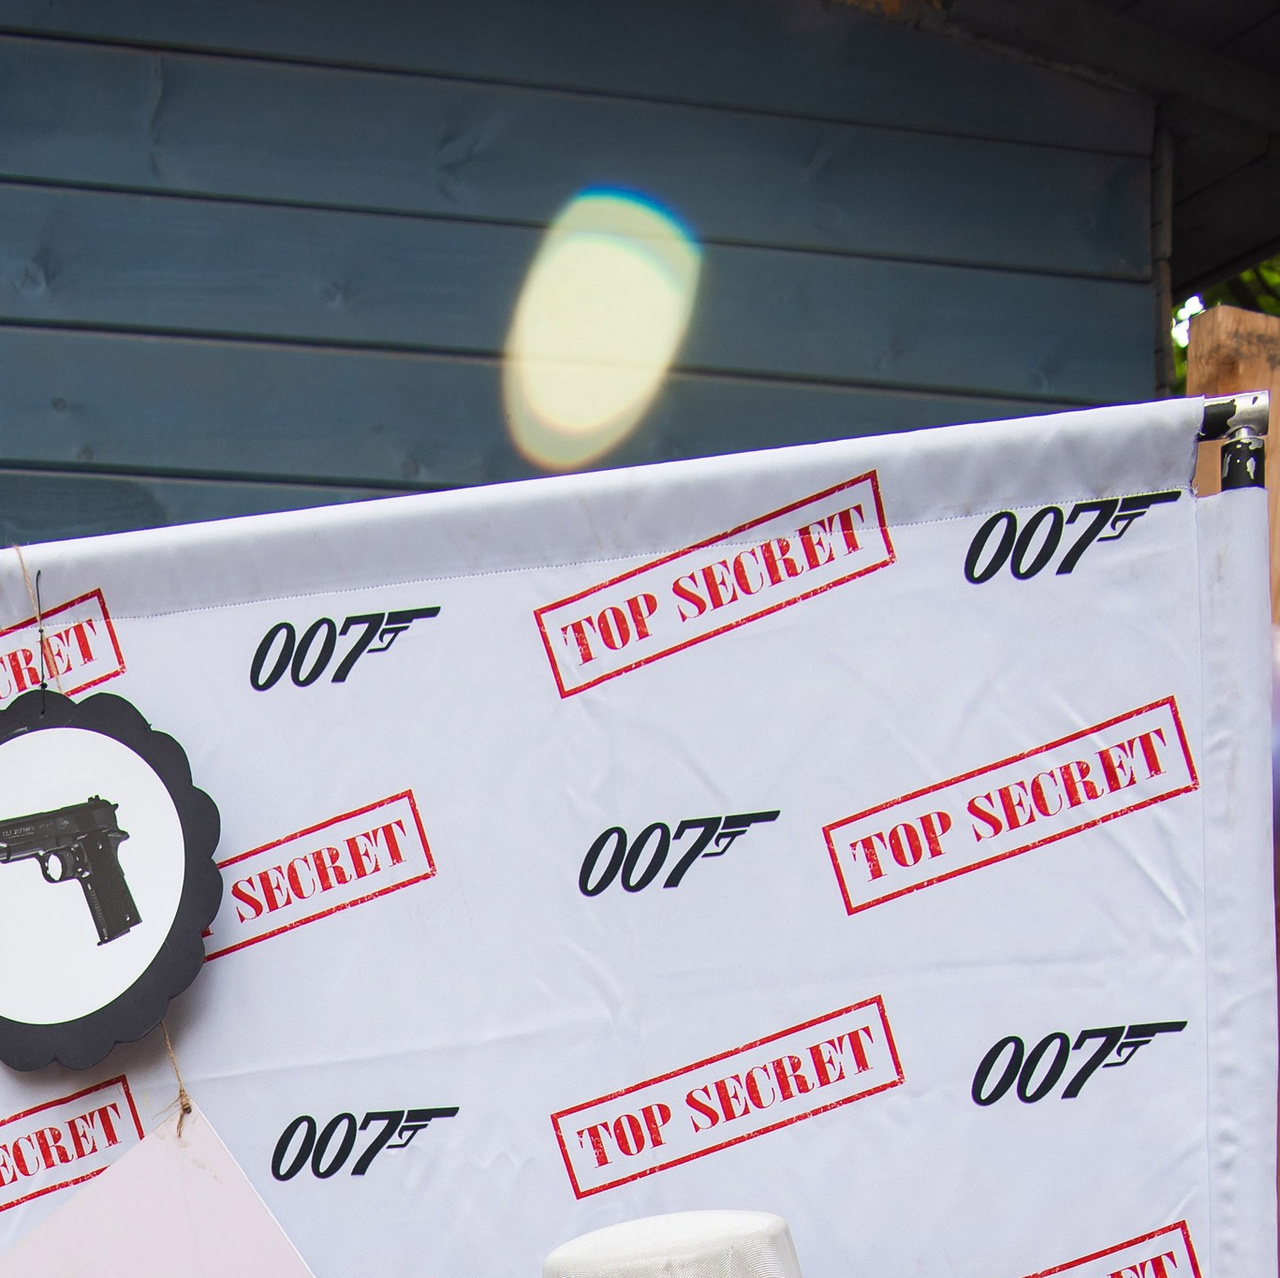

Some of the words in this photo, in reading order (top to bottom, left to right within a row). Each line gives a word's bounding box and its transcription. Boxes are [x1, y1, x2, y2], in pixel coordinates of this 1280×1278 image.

[964, 498, 1120, 584] 007
[561, 593, 658, 665] TOP
[671, 504, 864, 622] SECRET
[251, 612, 386, 691] 007
[850, 811, 953, 881] TOP
[966, 728, 1167, 842] SECRET
[231, 818, 407, 924] SECRET
[580, 817, 722, 897] 007
[577, 1103, 672, 1168] TOP
[685, 1026, 874, 1134] SECRET
[972, 1026, 1126, 1106] 007
[272, 1111, 405, 1181] 007
